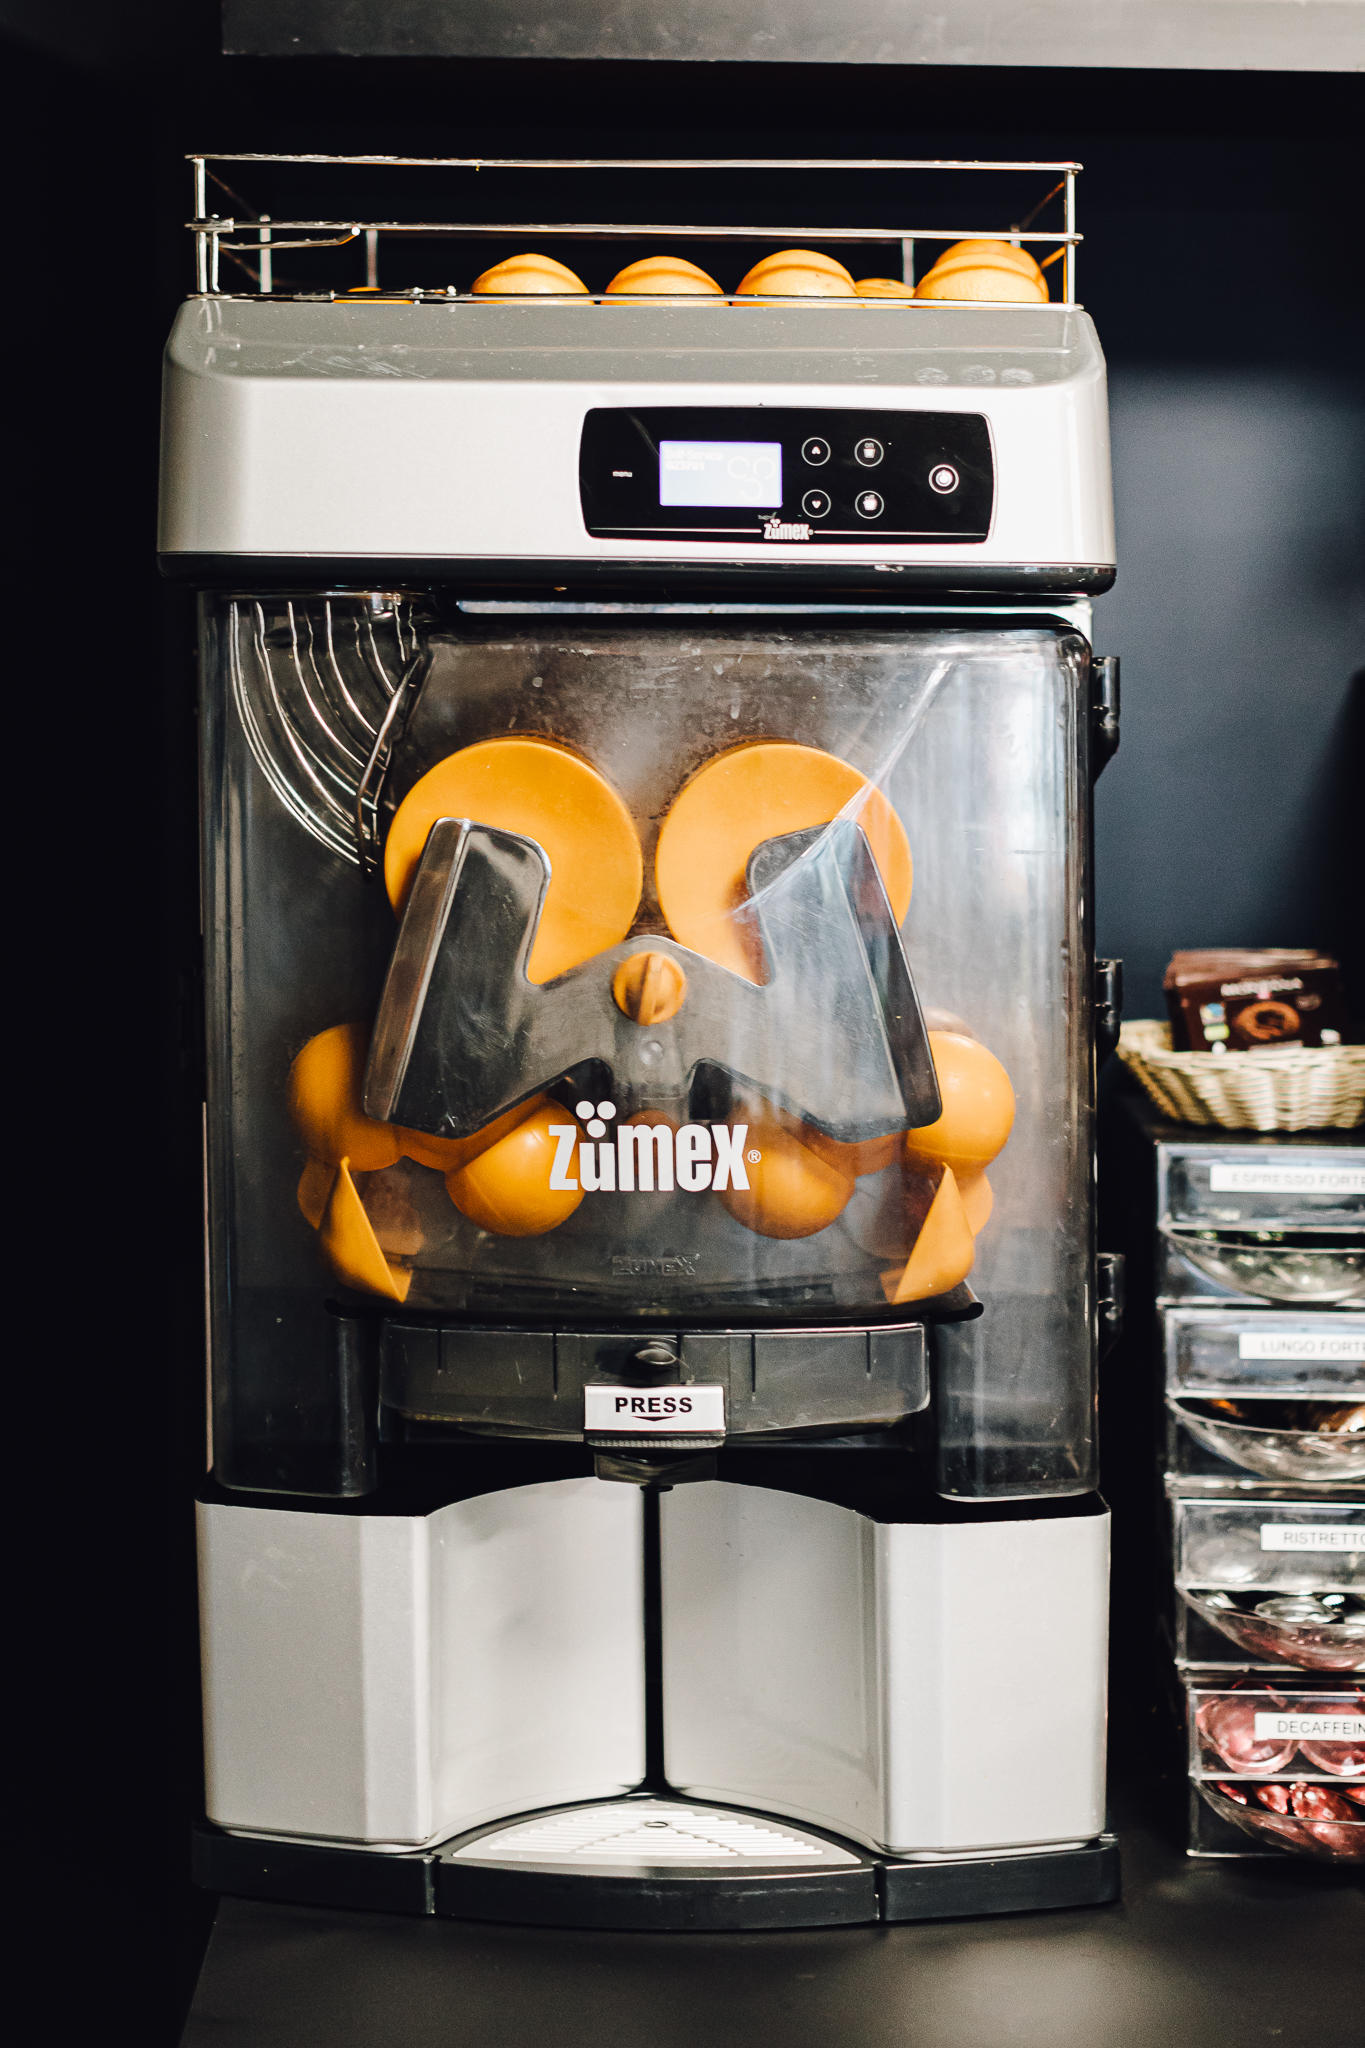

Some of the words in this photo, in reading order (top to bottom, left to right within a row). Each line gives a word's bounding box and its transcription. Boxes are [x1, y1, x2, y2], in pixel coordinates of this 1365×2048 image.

[1232, 1173, 1314, 1186] ESPRESSO
[1261, 1339, 1316, 1353] LUNGO
[615, 1397, 692, 1413] PRESS
